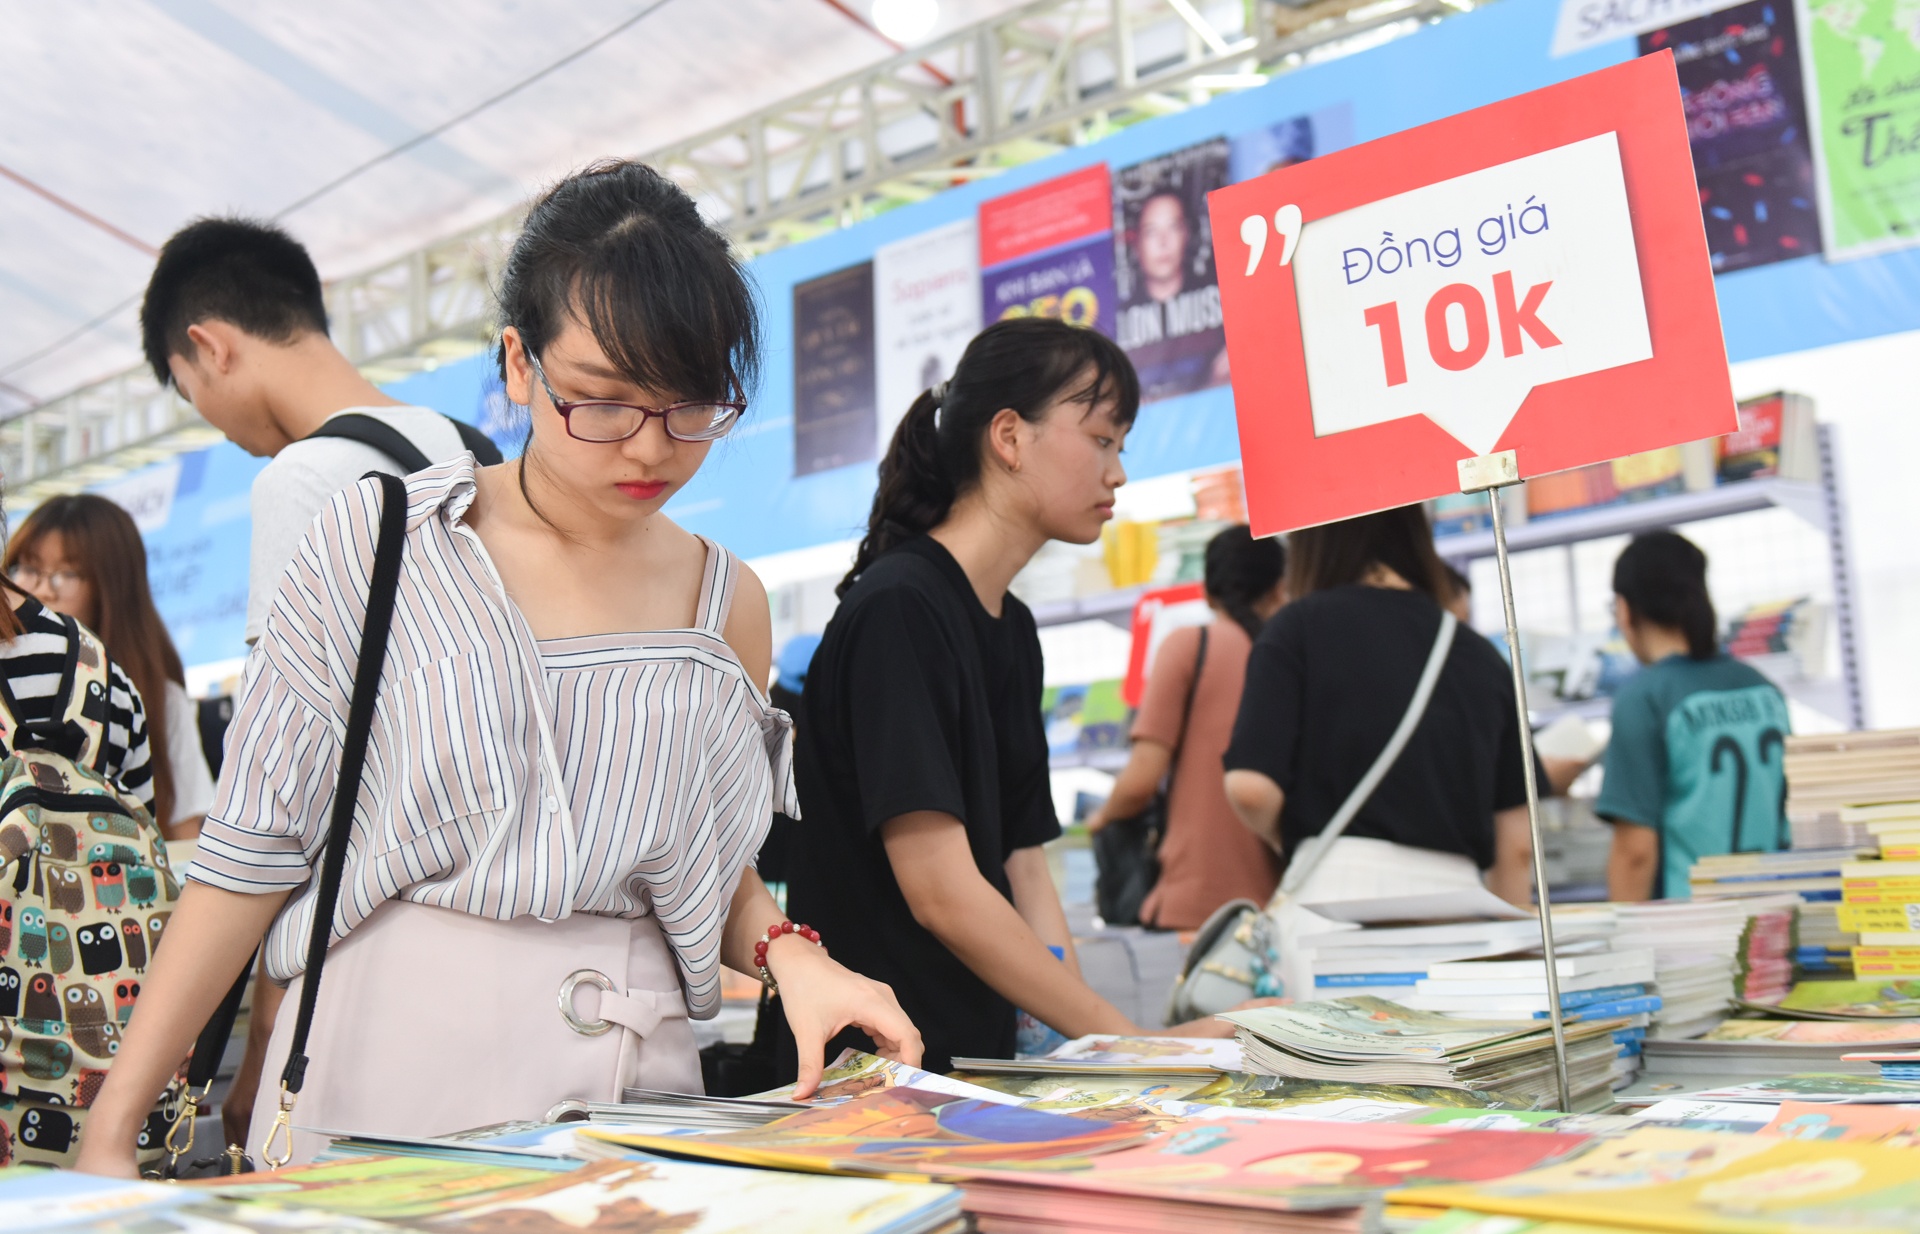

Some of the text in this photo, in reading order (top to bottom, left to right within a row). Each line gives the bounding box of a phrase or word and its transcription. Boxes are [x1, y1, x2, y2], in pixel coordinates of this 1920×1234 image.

[1341, 194, 1550, 286] Đồng giá
[999, 285, 1099, 330] EO
[1115, 284, 1224, 352] LON MUS
[1363, 269, 1564, 388] 10k
[1710, 725, 1794, 854] 22
